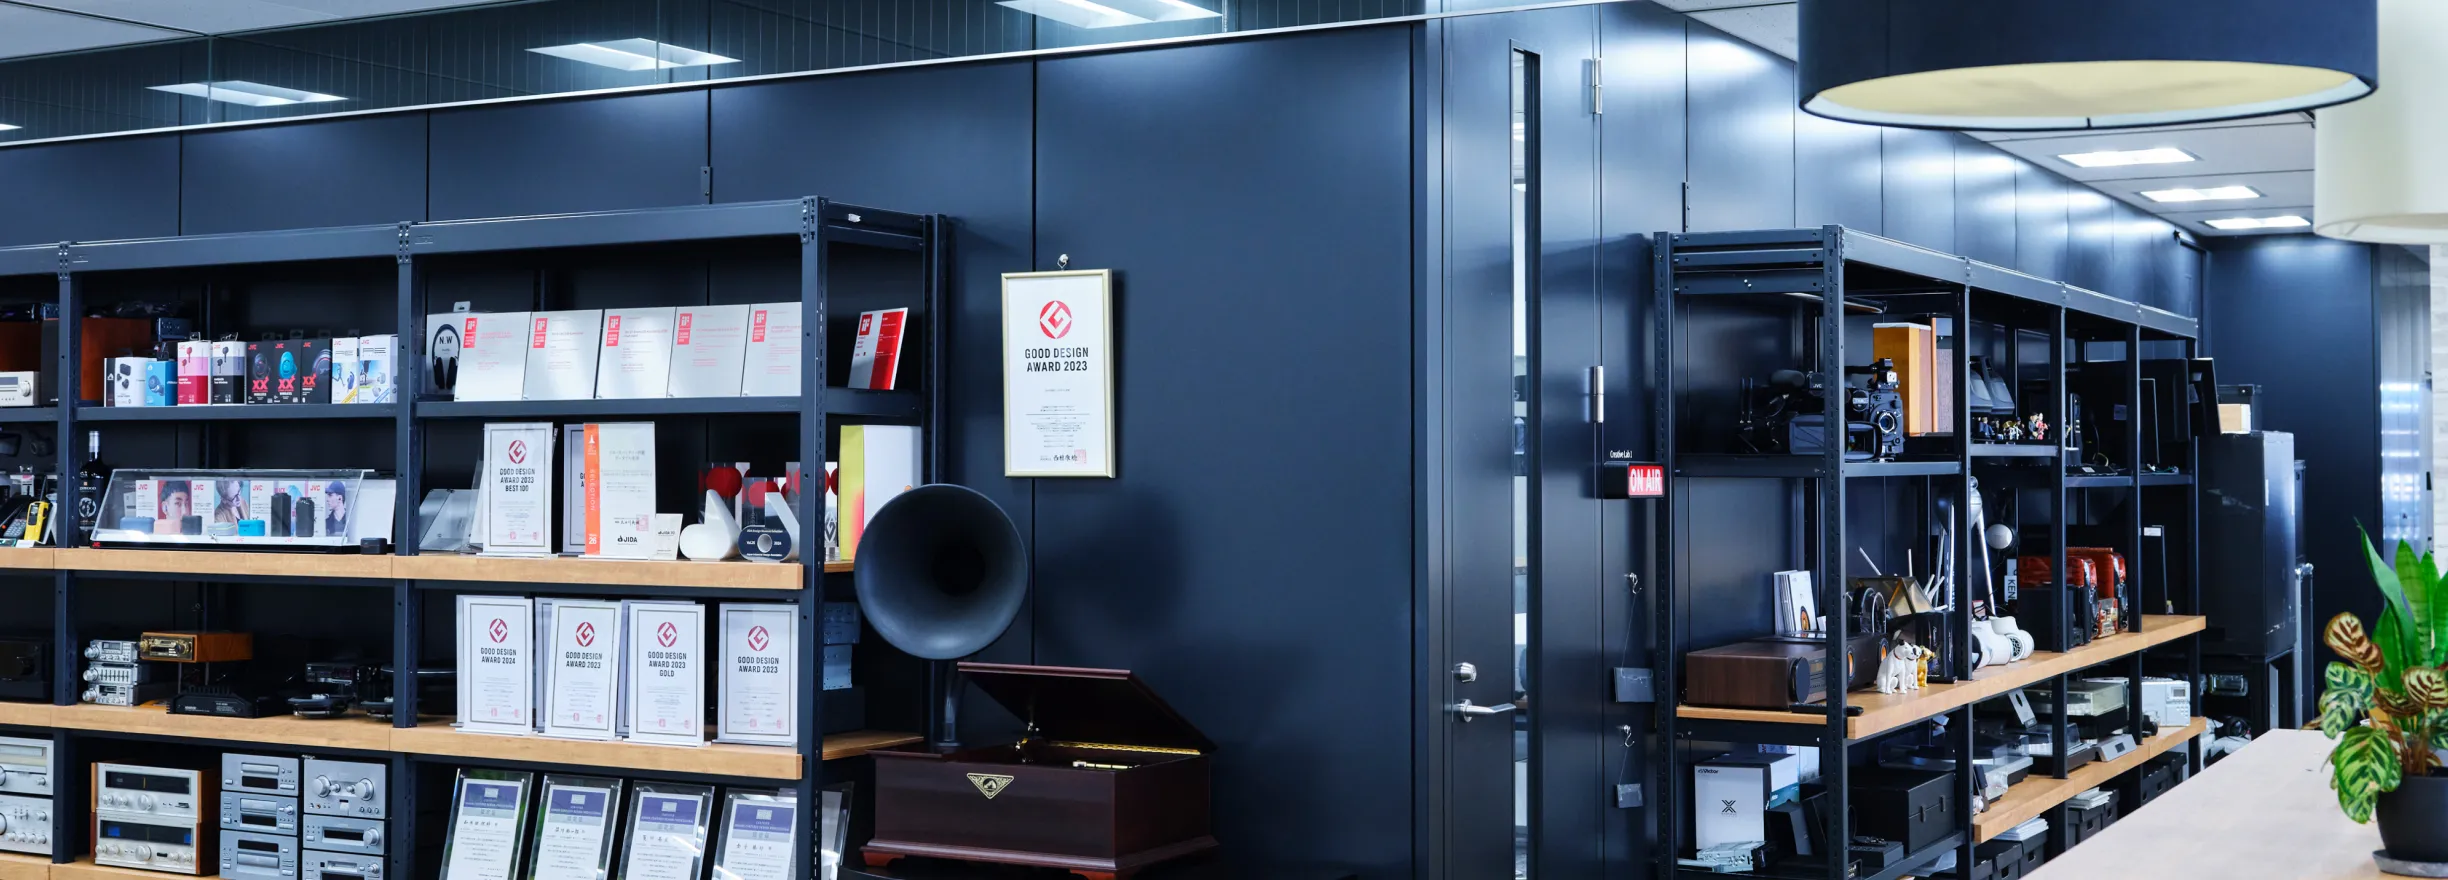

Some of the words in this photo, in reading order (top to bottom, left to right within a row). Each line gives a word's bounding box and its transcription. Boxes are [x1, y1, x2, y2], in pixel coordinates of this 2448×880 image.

[1024, 348, 1050, 359] GOOD
[1053, 347, 1089, 358] DESIGN
[1026, 361, 1061, 372] AWARD
[1064, 360, 1088, 371] 2023
[500, 468, 514, 476] GOOD
[1630, 468, 1643, 493] ON
[1646, 468, 1661, 493] AIR
[588, 537, 597, 545] 26
[480, 647, 495, 655] GOOD
[497, 648, 517, 656] DESIGN
[648, 651, 664, 659] GOOD
[665, 651, 687, 660] DESIGN
[481, 656, 501, 664] AWARD
[582, 652, 603, 660] DESIGN
[737, 656, 755, 664] GOOD
[566, 660, 586, 668] AWARD
[587, 661, 601, 669] 2023
[649, 660, 670, 668] AWARD
[671, 661, 686, 669] 2023
[659, 669, 675, 677] GOLD
[738, 665, 761, 673] AWARD
